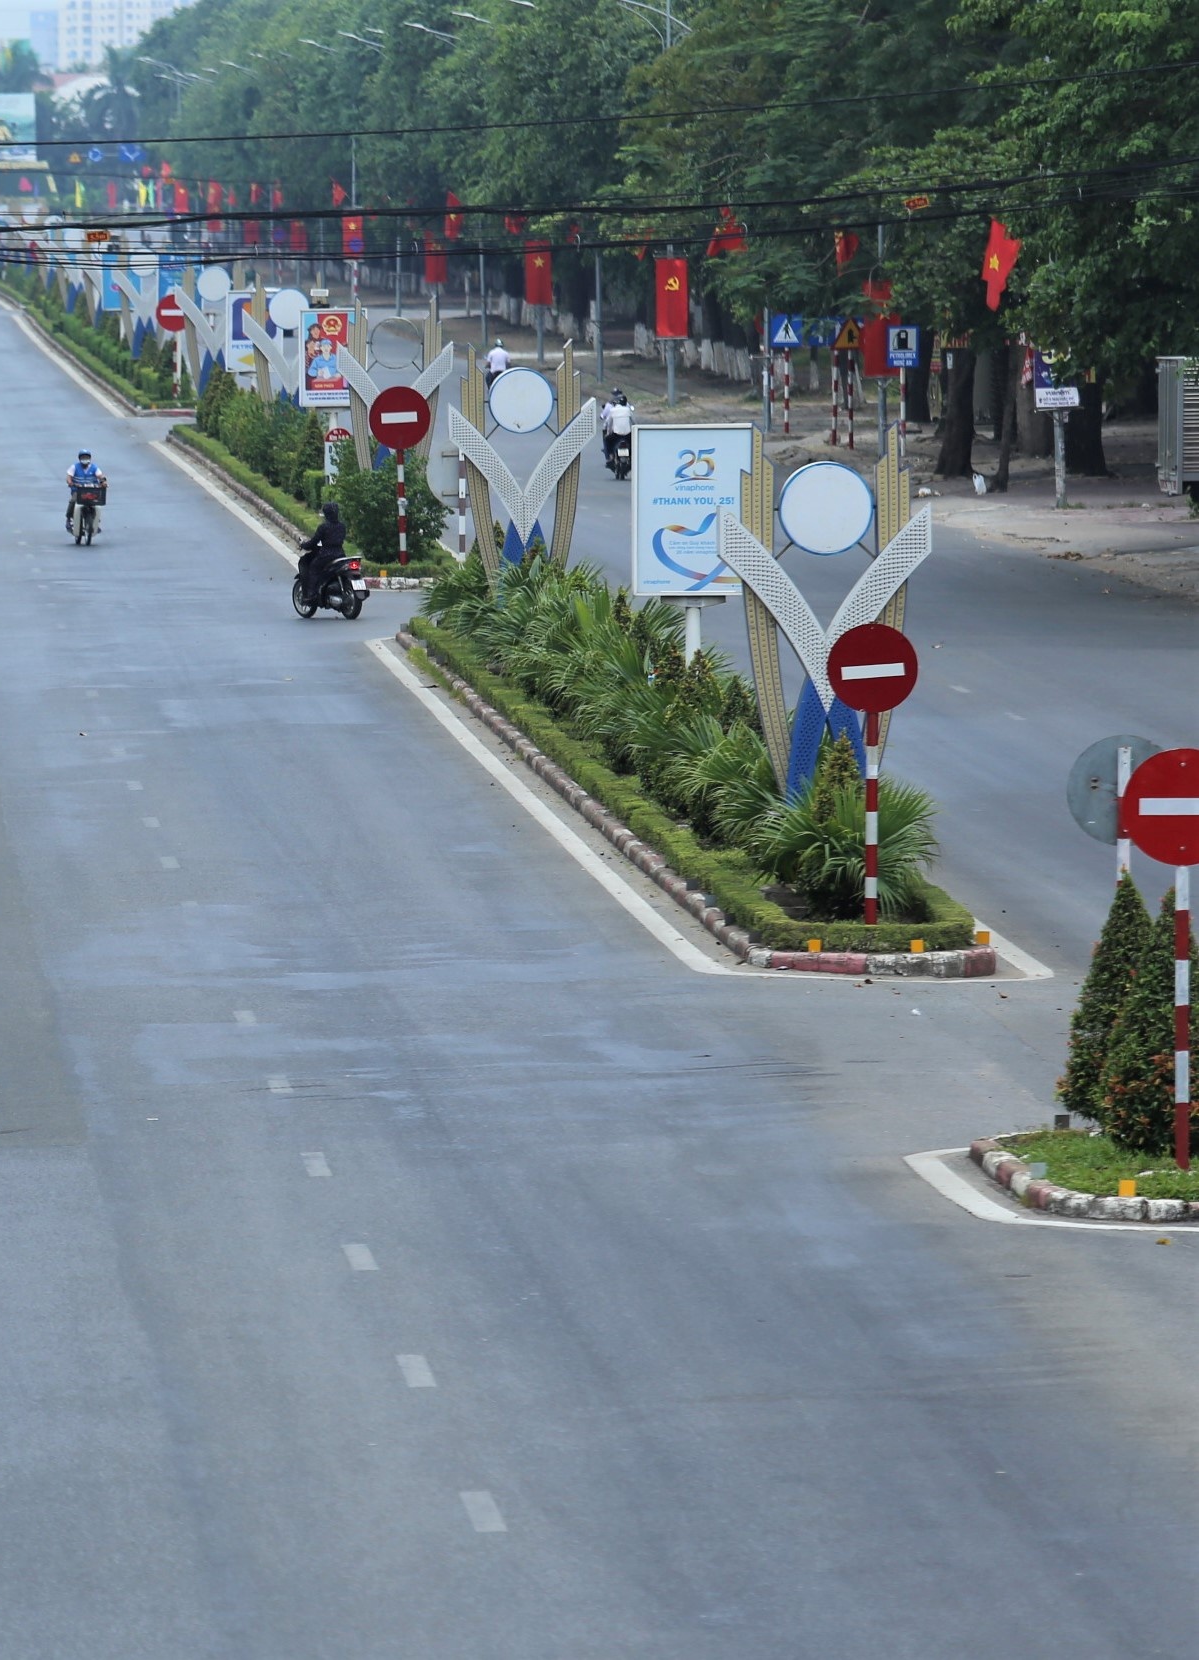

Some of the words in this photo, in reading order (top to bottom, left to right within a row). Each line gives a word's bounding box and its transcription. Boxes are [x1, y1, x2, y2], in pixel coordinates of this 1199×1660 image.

[674, 448, 716, 479] 25
[675, 484, 715, 493] vinaphone
[653, 497, 691, 506] #THANK
[694, 497, 717, 507] YOU,
[719, 496, 735, 505] 25!
